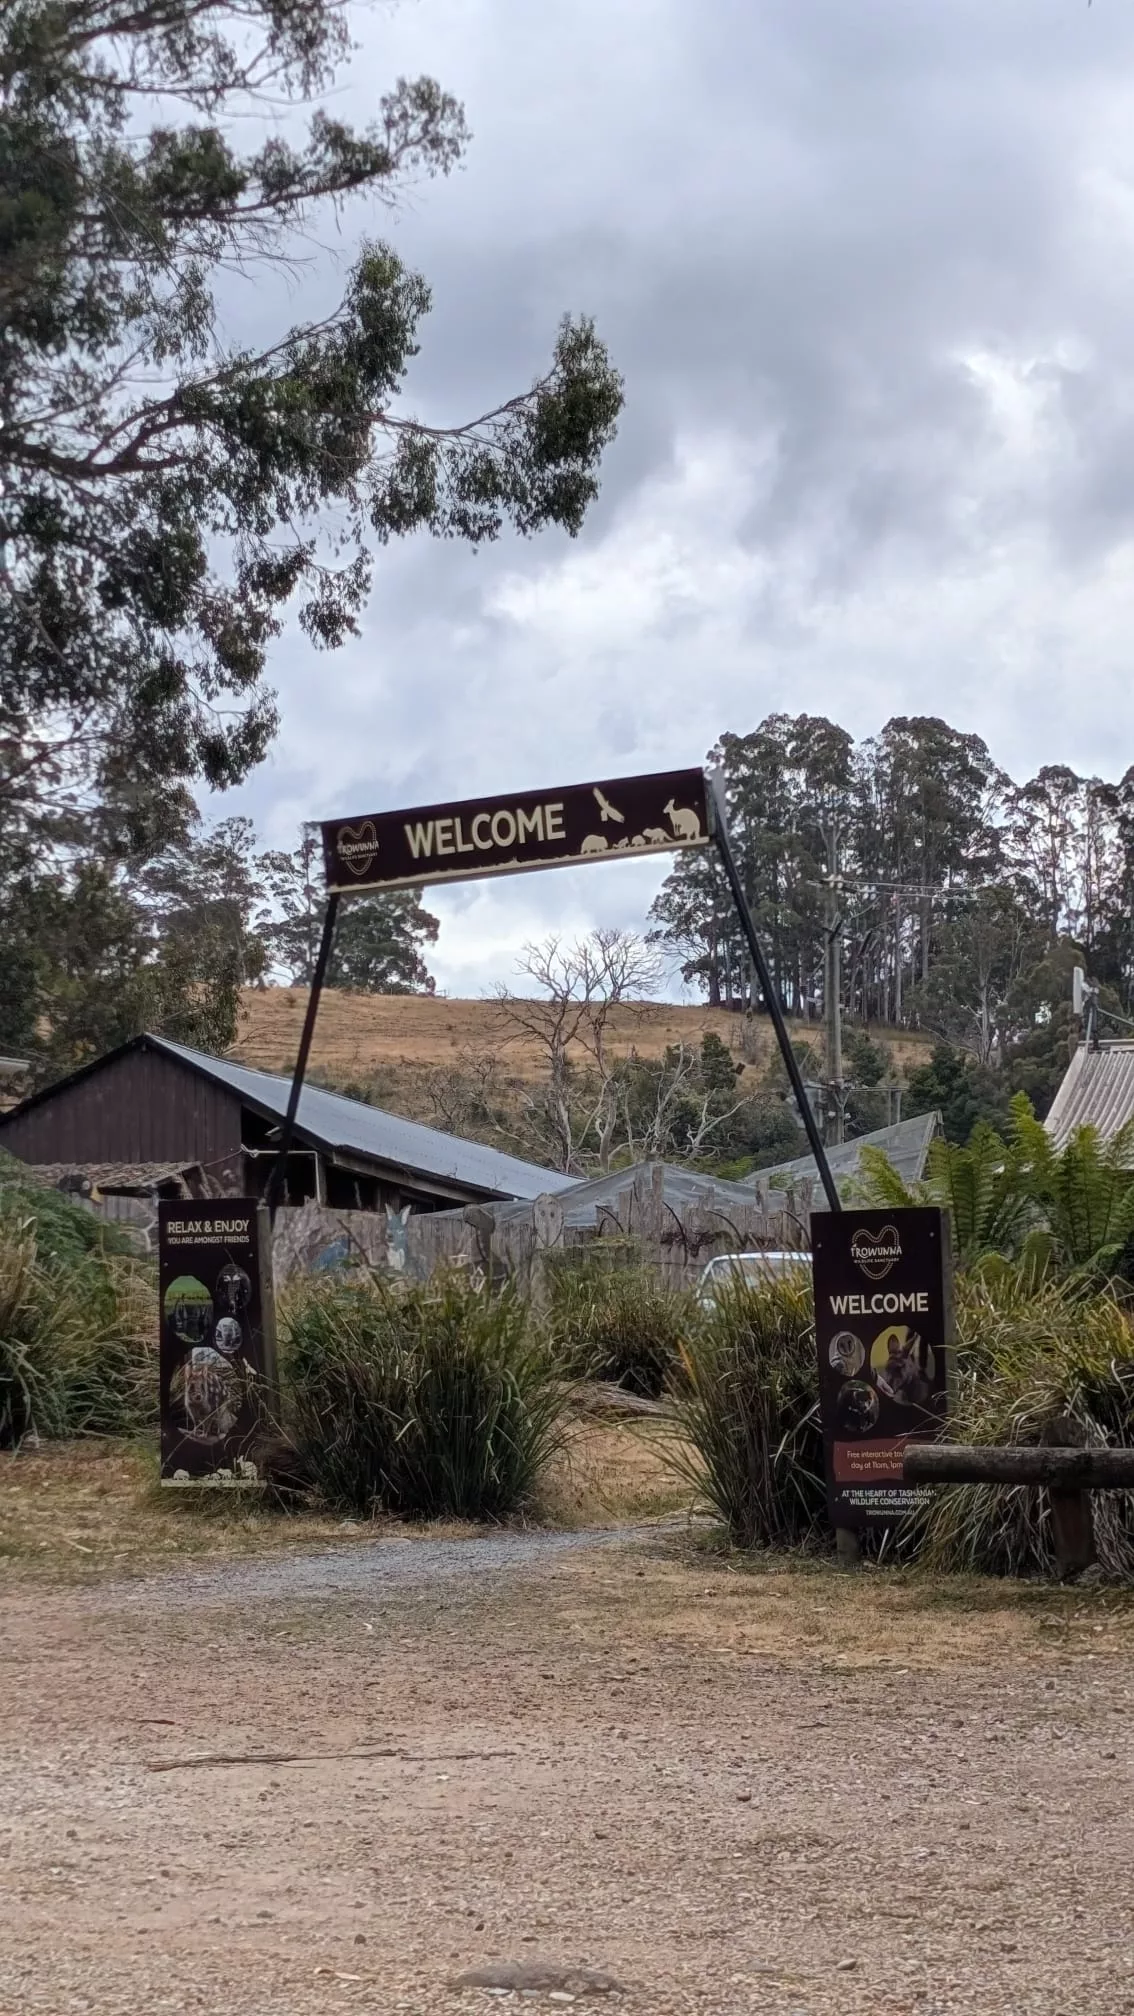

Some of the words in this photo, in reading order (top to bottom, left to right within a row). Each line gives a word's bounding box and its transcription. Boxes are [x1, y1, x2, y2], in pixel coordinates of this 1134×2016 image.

[404, 803, 566, 859] WELCOME
[337, 840, 379, 855] TROWUNNA
[167, 1221, 202, 1234] RELAX
[204, 1220, 212, 1233] &
[214, 1219, 250, 1233] ENJOY
[167, 1236, 181, 1245] YOU
[181, 1236, 193, 1244] ARE
[194, 1236, 223, 1244] AMONGST
[224, 1235, 250, 1243] FRIENDS
[851, 1245, 903, 1258] TROWUNNA
[829, 1292, 929, 1315] WELCOME
[847, 1450, 860, 1459] Free
[861, 1450, 893, 1458] interactive
[850, 1461, 864, 1471] day
[864, 1461, 871, 1469] at
[842, 1489, 850, 1498] AT
[850, 1489, 864, 1498] THE
[865, 1489, 887, 1498] HEART
[888, 1489, 898, 1498] OF
[849, 1497, 879, 1506] WILDLIFE
[879, 1497, 930, 1505] CONSERVATION
